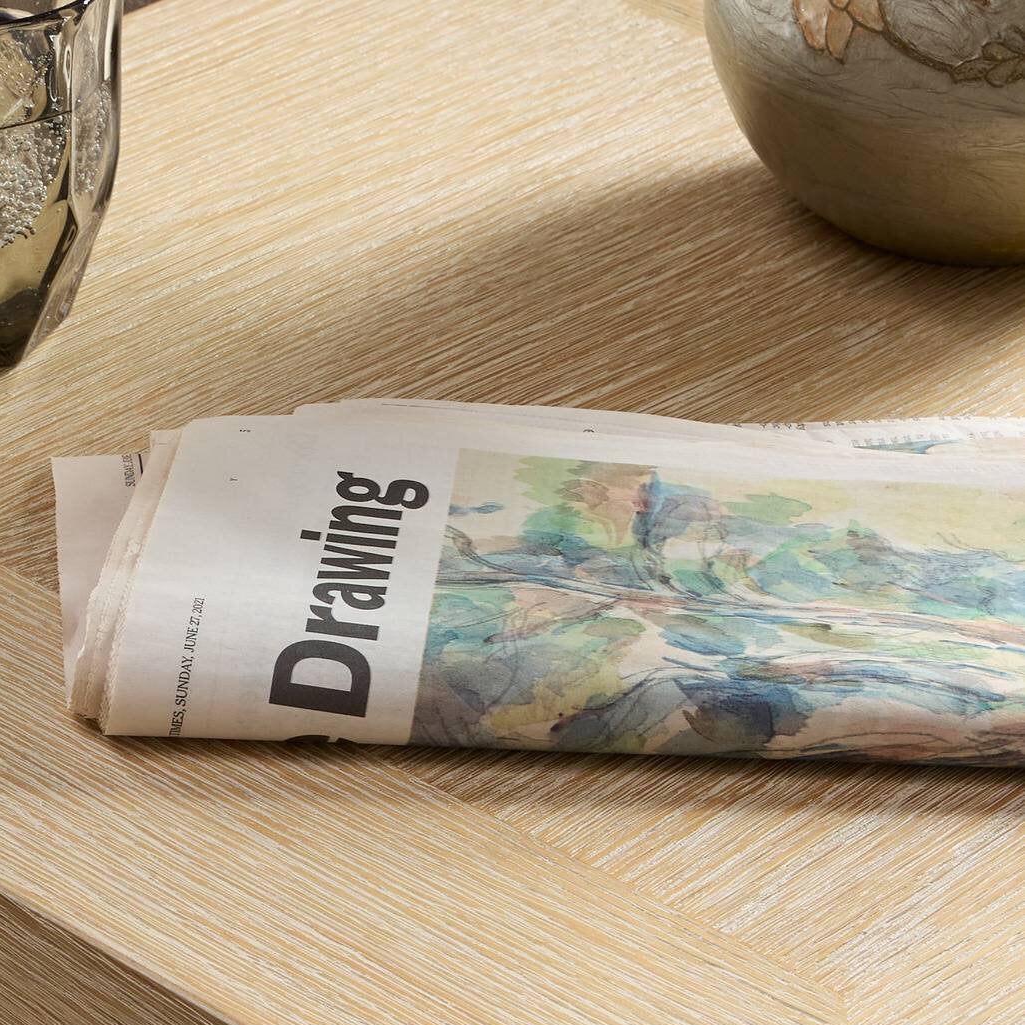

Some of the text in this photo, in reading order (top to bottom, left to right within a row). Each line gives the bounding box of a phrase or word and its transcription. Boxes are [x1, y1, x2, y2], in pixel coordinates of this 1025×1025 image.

[191, 597, 205, 614] 2021
[268, 470, 430, 719] Drawing
[189, 614, 203, 626] 27,
[183, 627, 199, 653] JUNE
[175, 655, 195, 707] SUNDAY,
